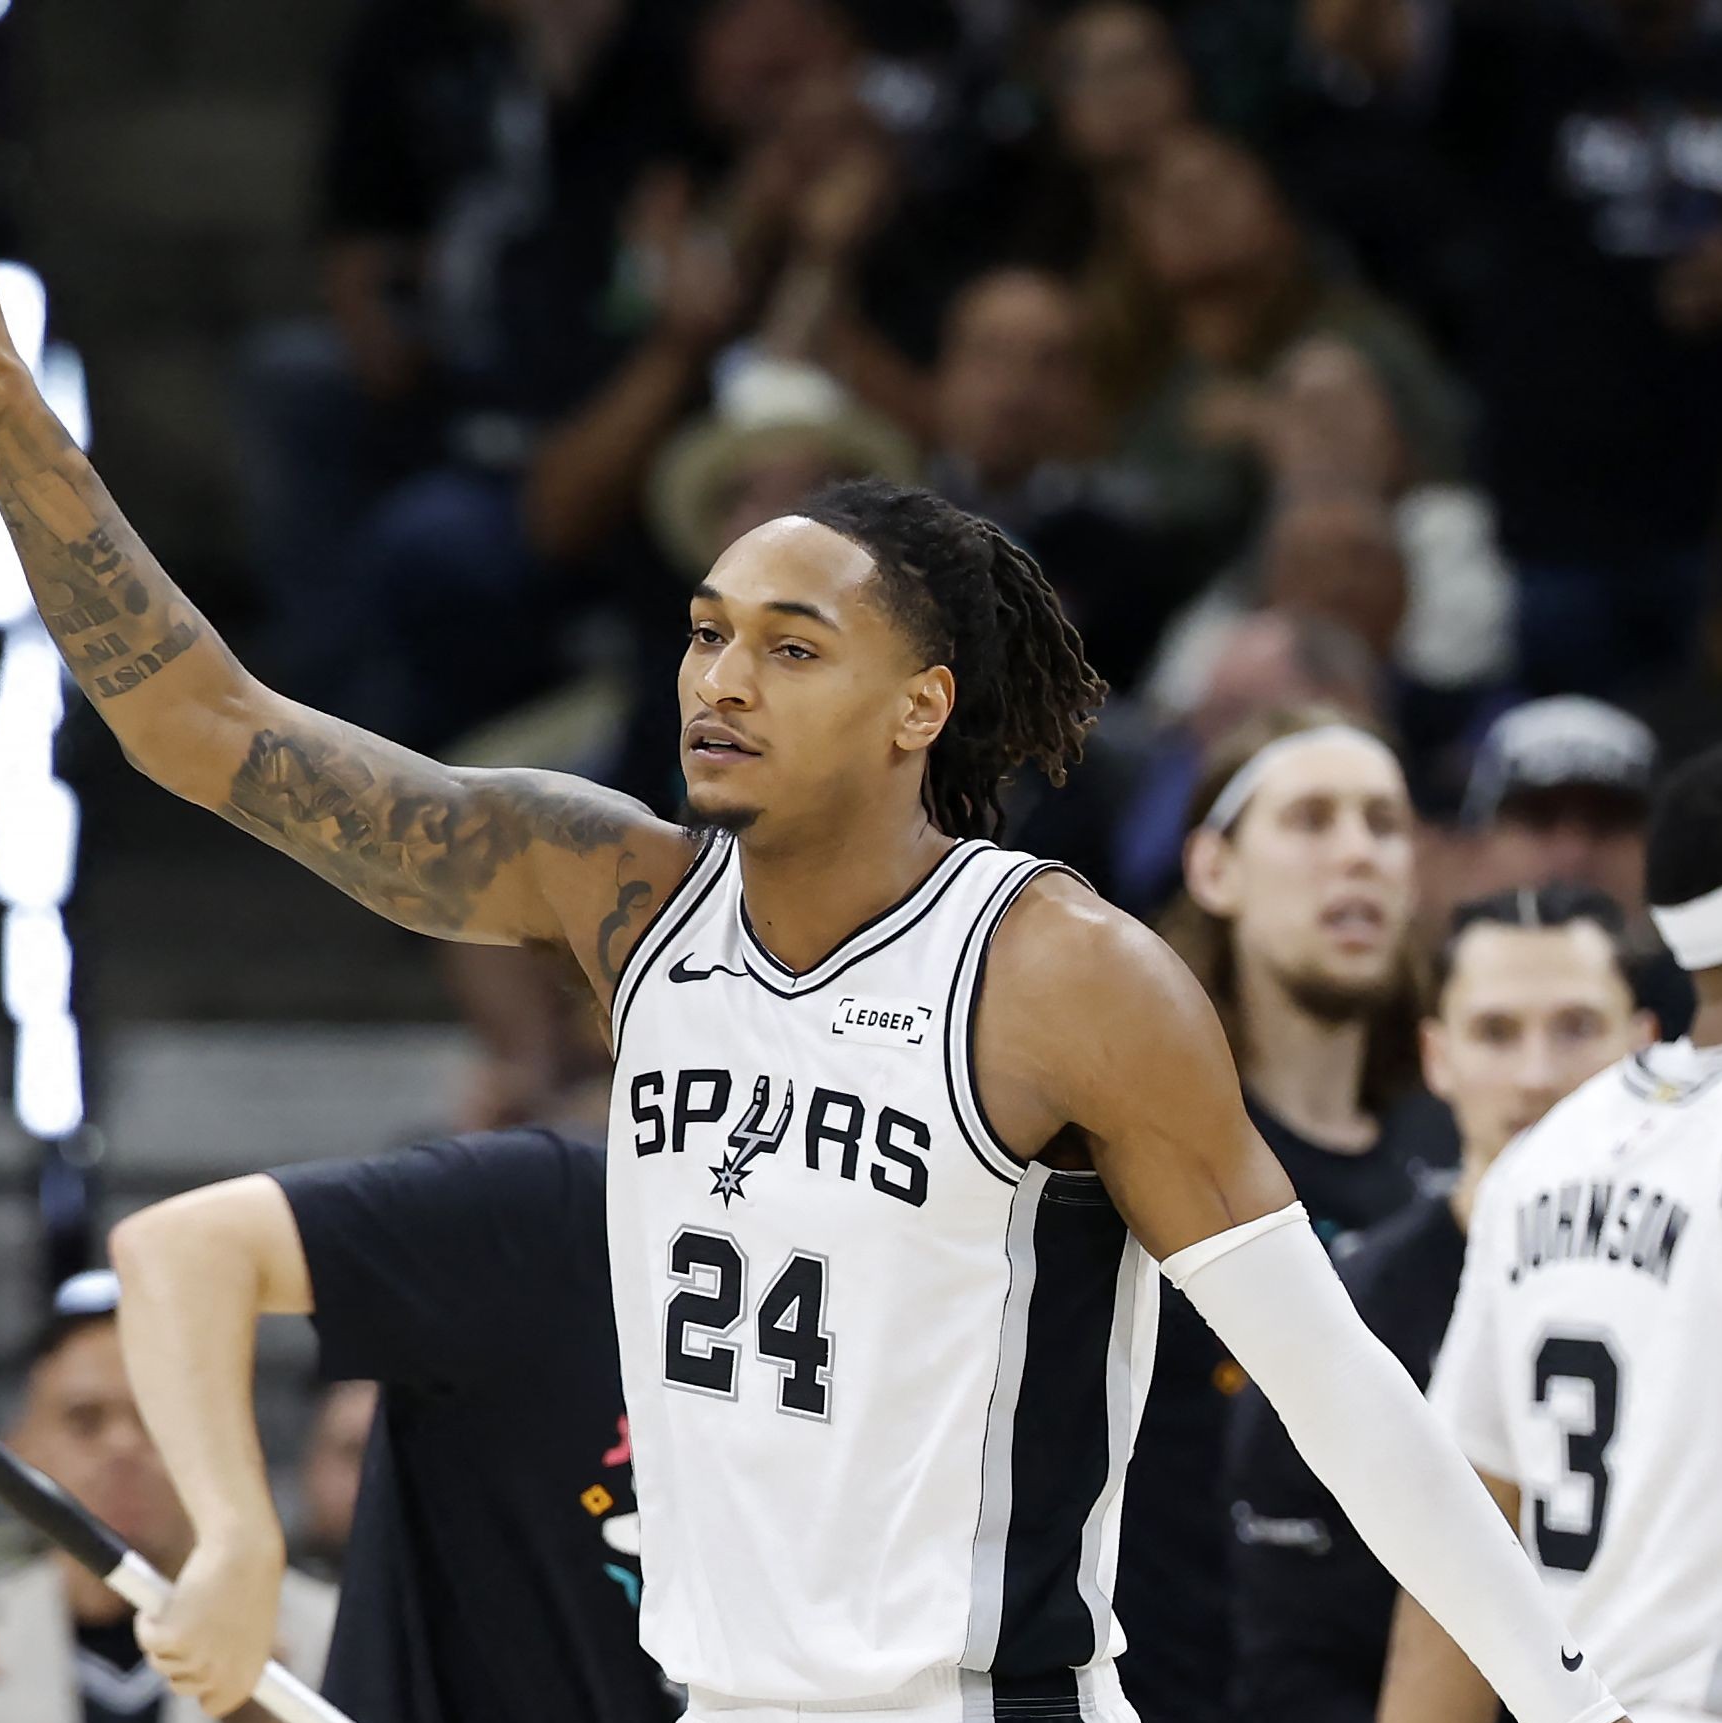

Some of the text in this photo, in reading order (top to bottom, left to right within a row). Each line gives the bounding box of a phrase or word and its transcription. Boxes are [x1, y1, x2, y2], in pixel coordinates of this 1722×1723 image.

[844, 1008, 915, 1032] LEDGER
[630, 1068, 932, 1208] SPURS
[1507, 1182, 1689, 1284] JOHNSON
[662, 1223, 836, 1424] 24
[1532, 1334, 1619, 1574] 3
